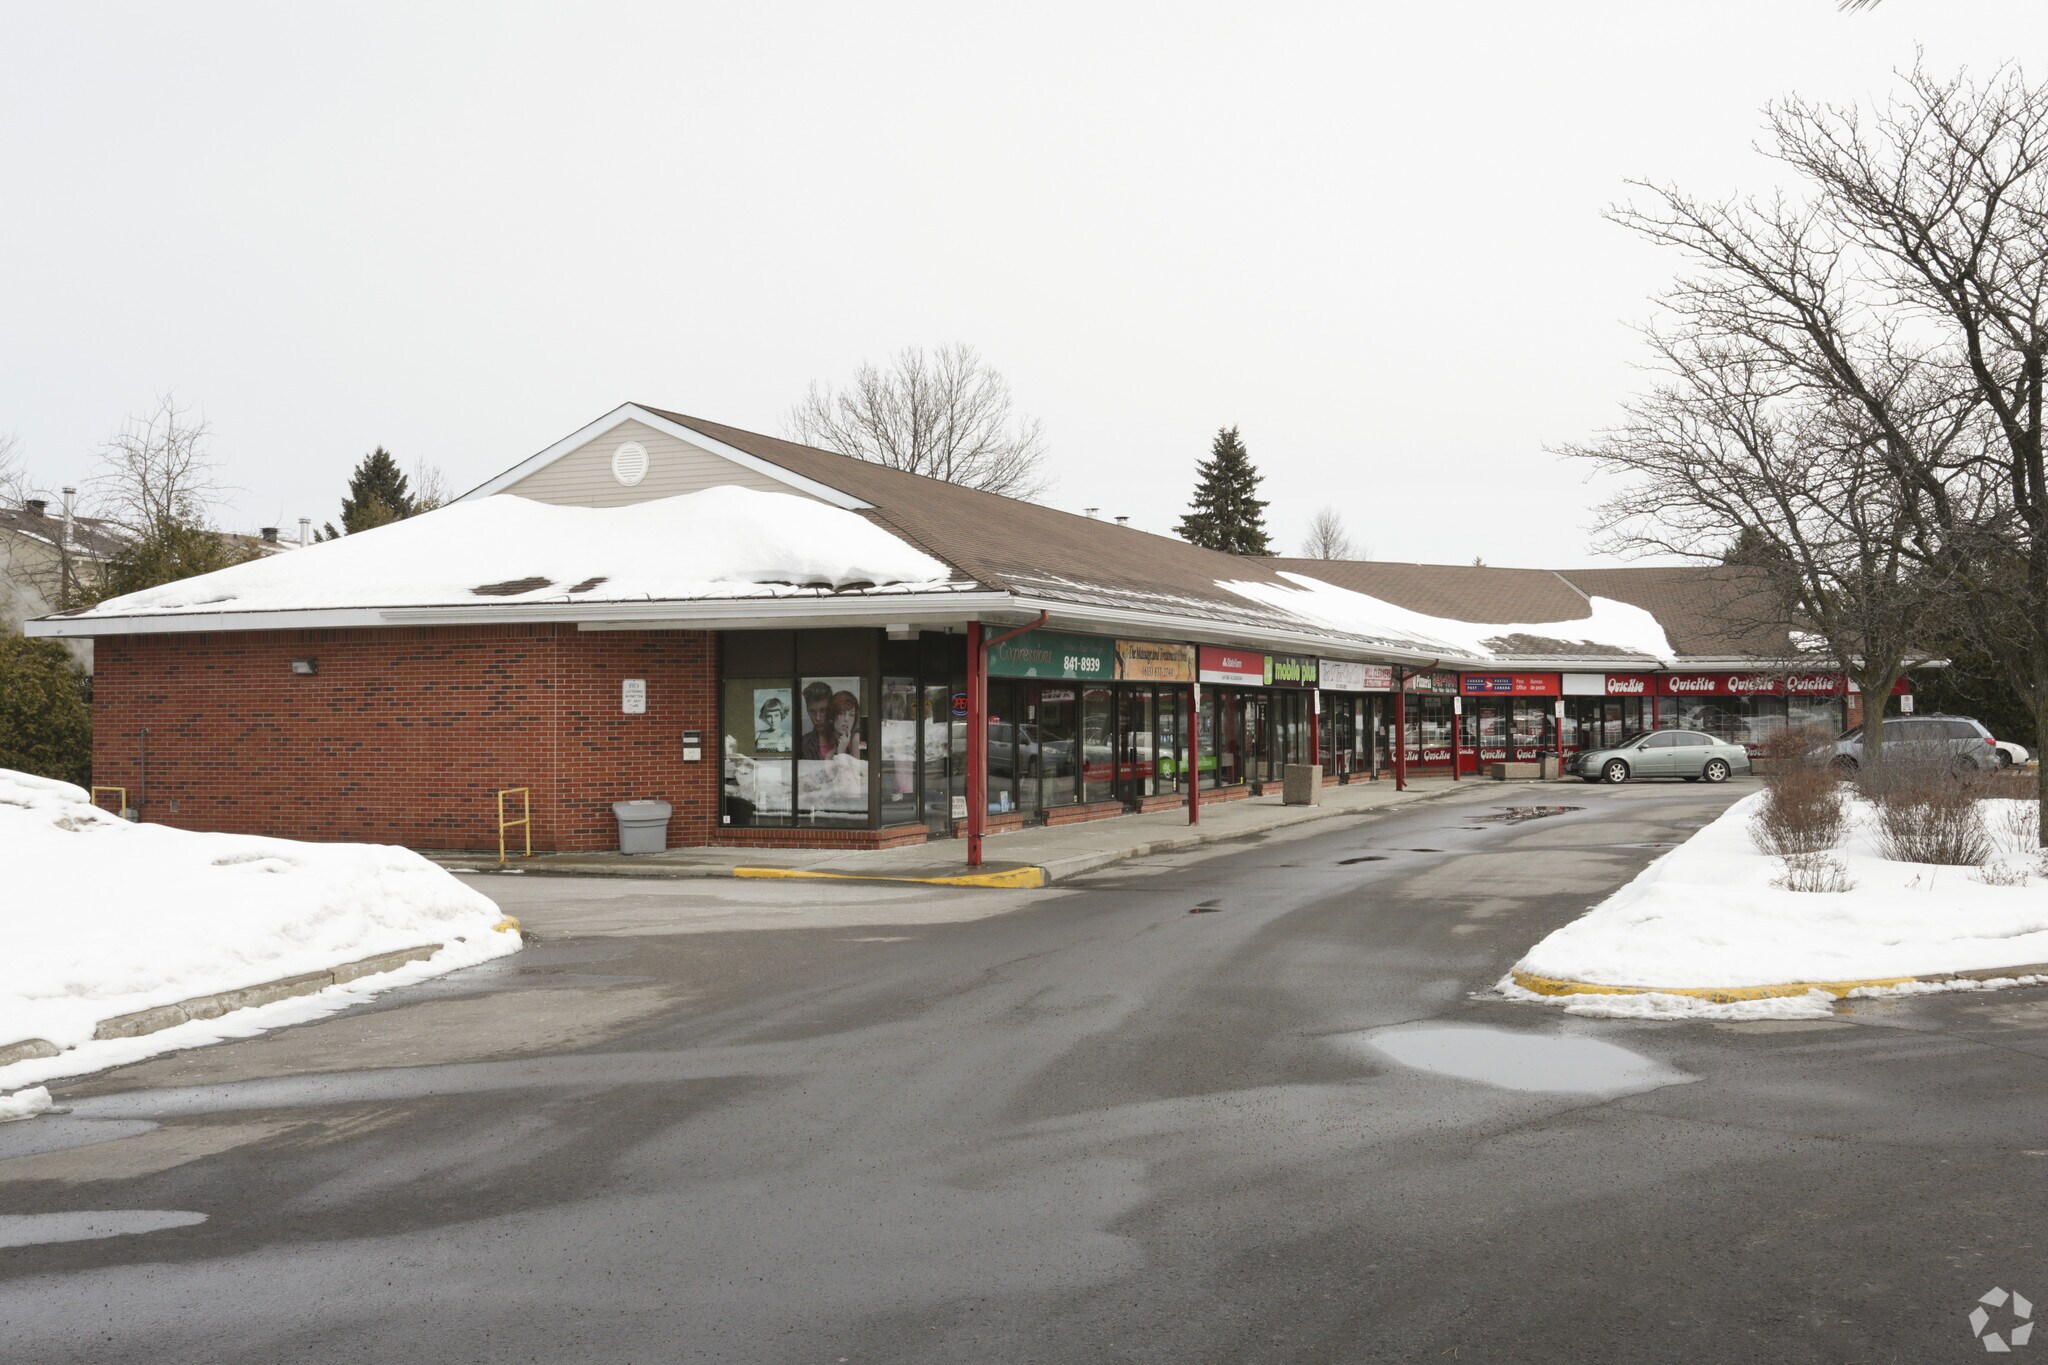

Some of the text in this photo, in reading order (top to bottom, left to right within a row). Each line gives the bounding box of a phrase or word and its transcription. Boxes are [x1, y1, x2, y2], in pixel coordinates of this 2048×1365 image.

[1063, 655, 1100, 672] 841-8939
[1275, 658, 1301, 681] mobile
[1301, 660, 1317, 687] plus
[1373, 668, 1392, 679] CLEANERS
